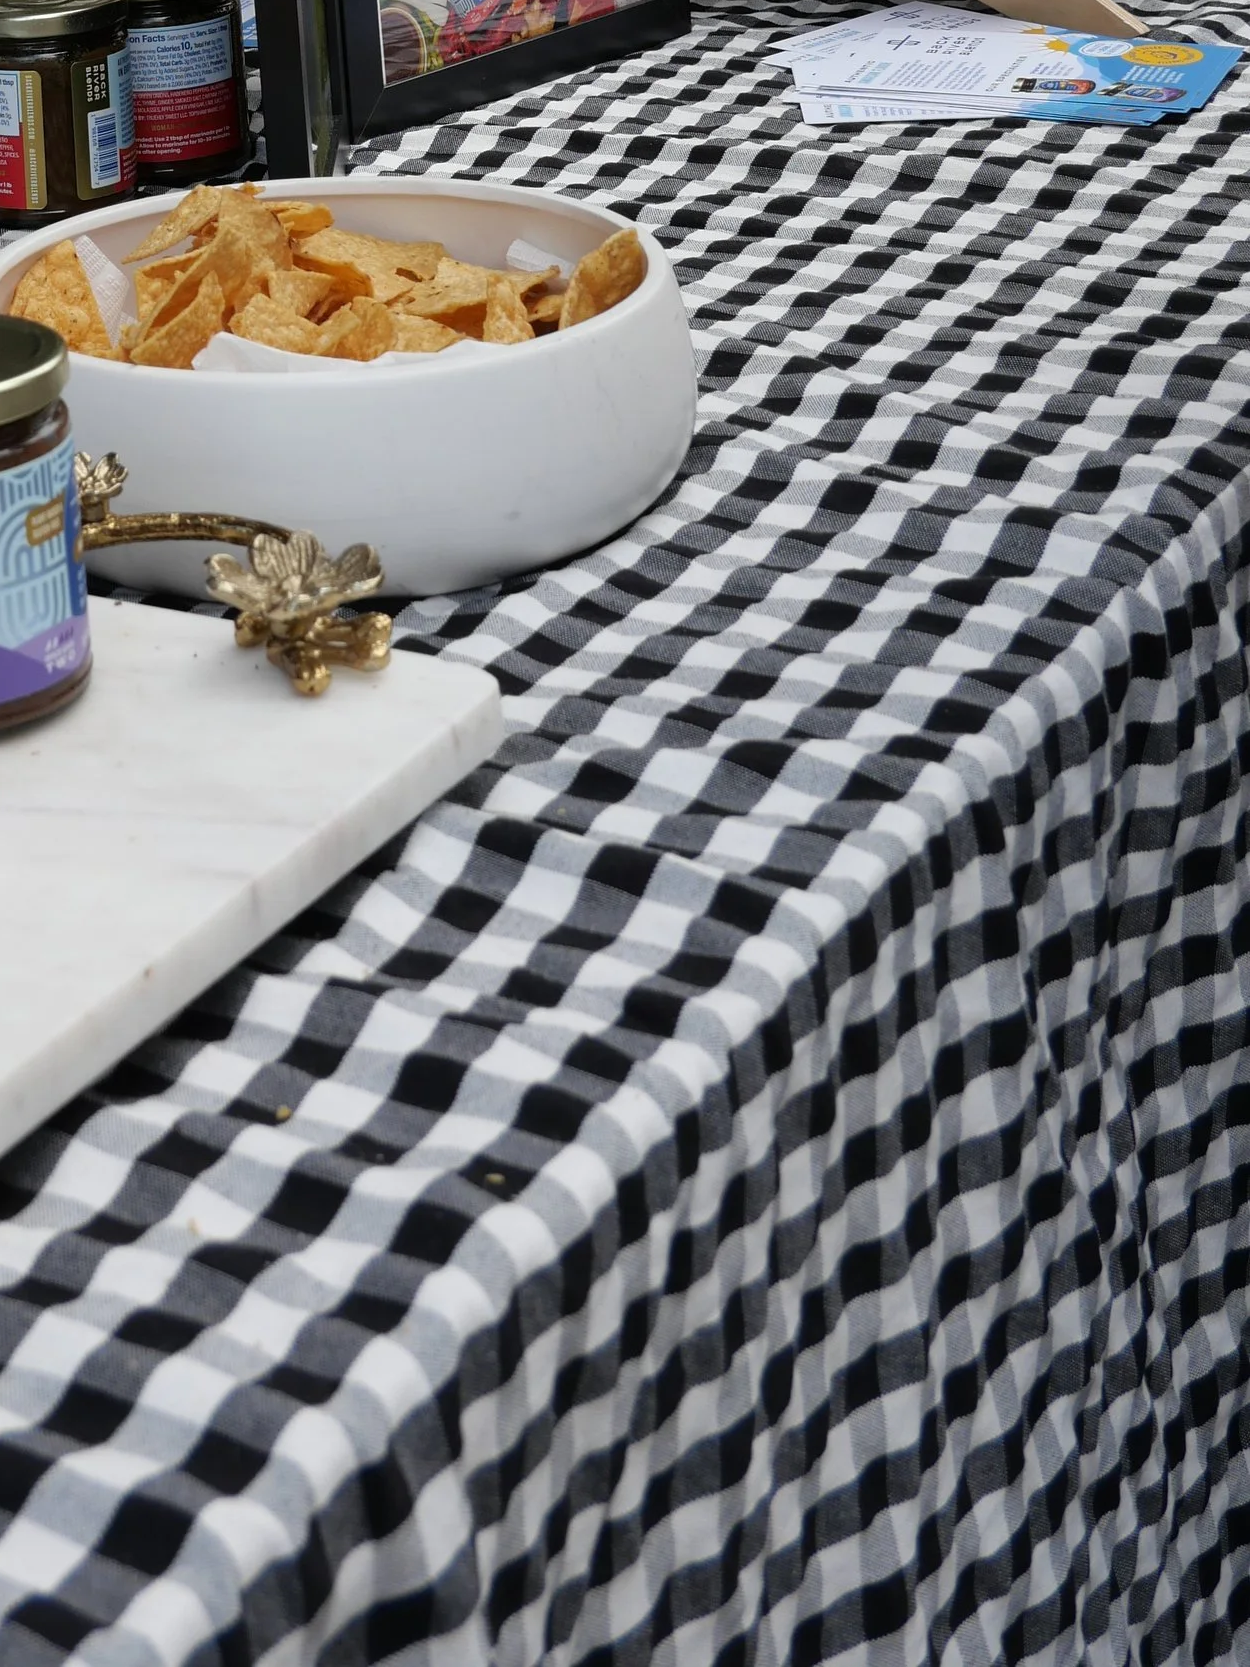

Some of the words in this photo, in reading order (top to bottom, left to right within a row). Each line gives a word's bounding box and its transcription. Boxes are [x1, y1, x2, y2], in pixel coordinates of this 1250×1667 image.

[142, 34, 166, 43] Facts
[156, 46, 180, 54] Calories
[180, 42, 193, 51] 10,
[2, 78, 14, 86] tbsp
[170, 134, 184, 142] tbsp
